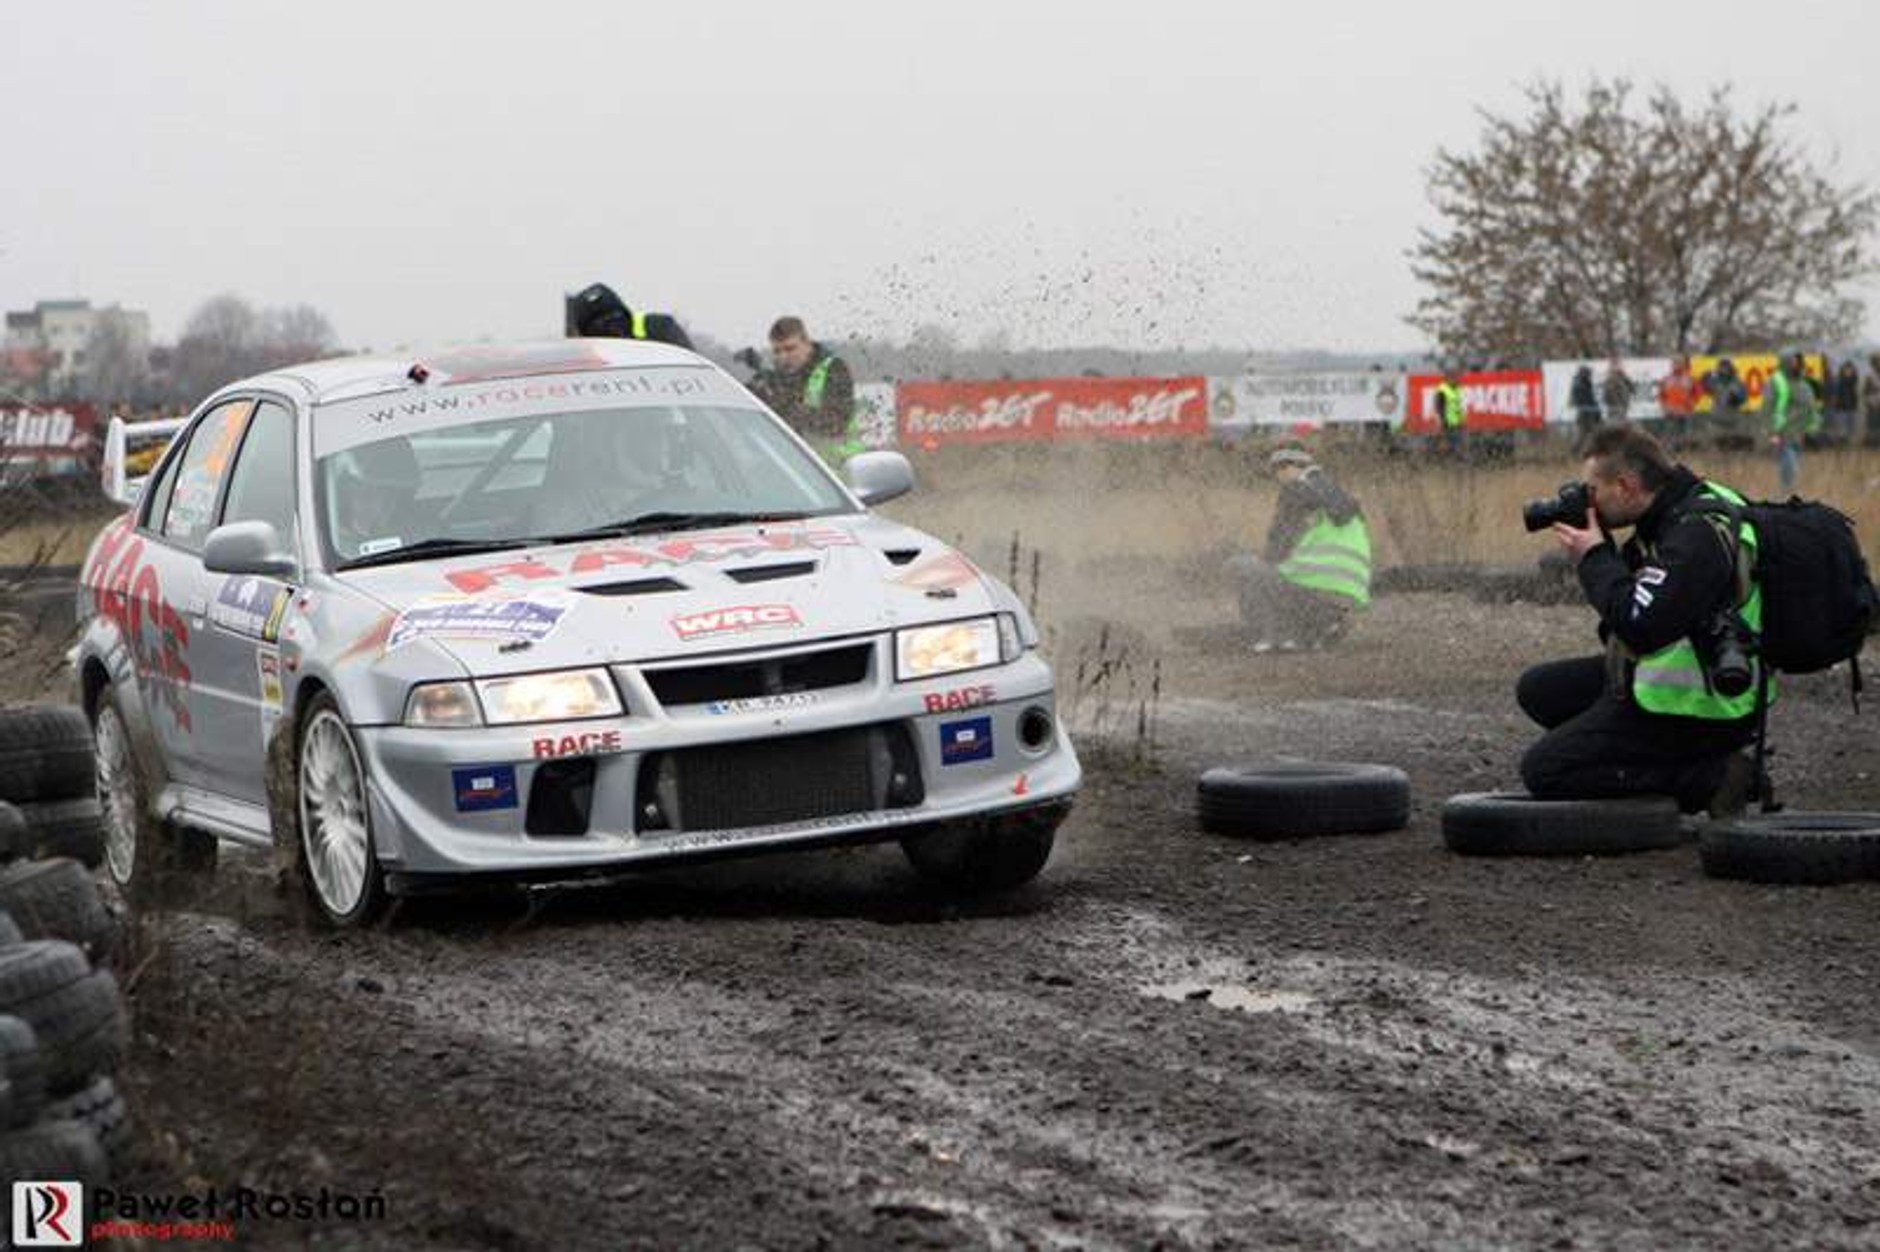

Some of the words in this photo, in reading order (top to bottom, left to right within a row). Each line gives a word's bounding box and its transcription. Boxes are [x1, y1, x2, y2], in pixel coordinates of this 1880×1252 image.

[369, 374, 707, 424] www.racerent.pl
[676, 608, 793, 632] WRC
[532, 730, 621, 759] RACE
